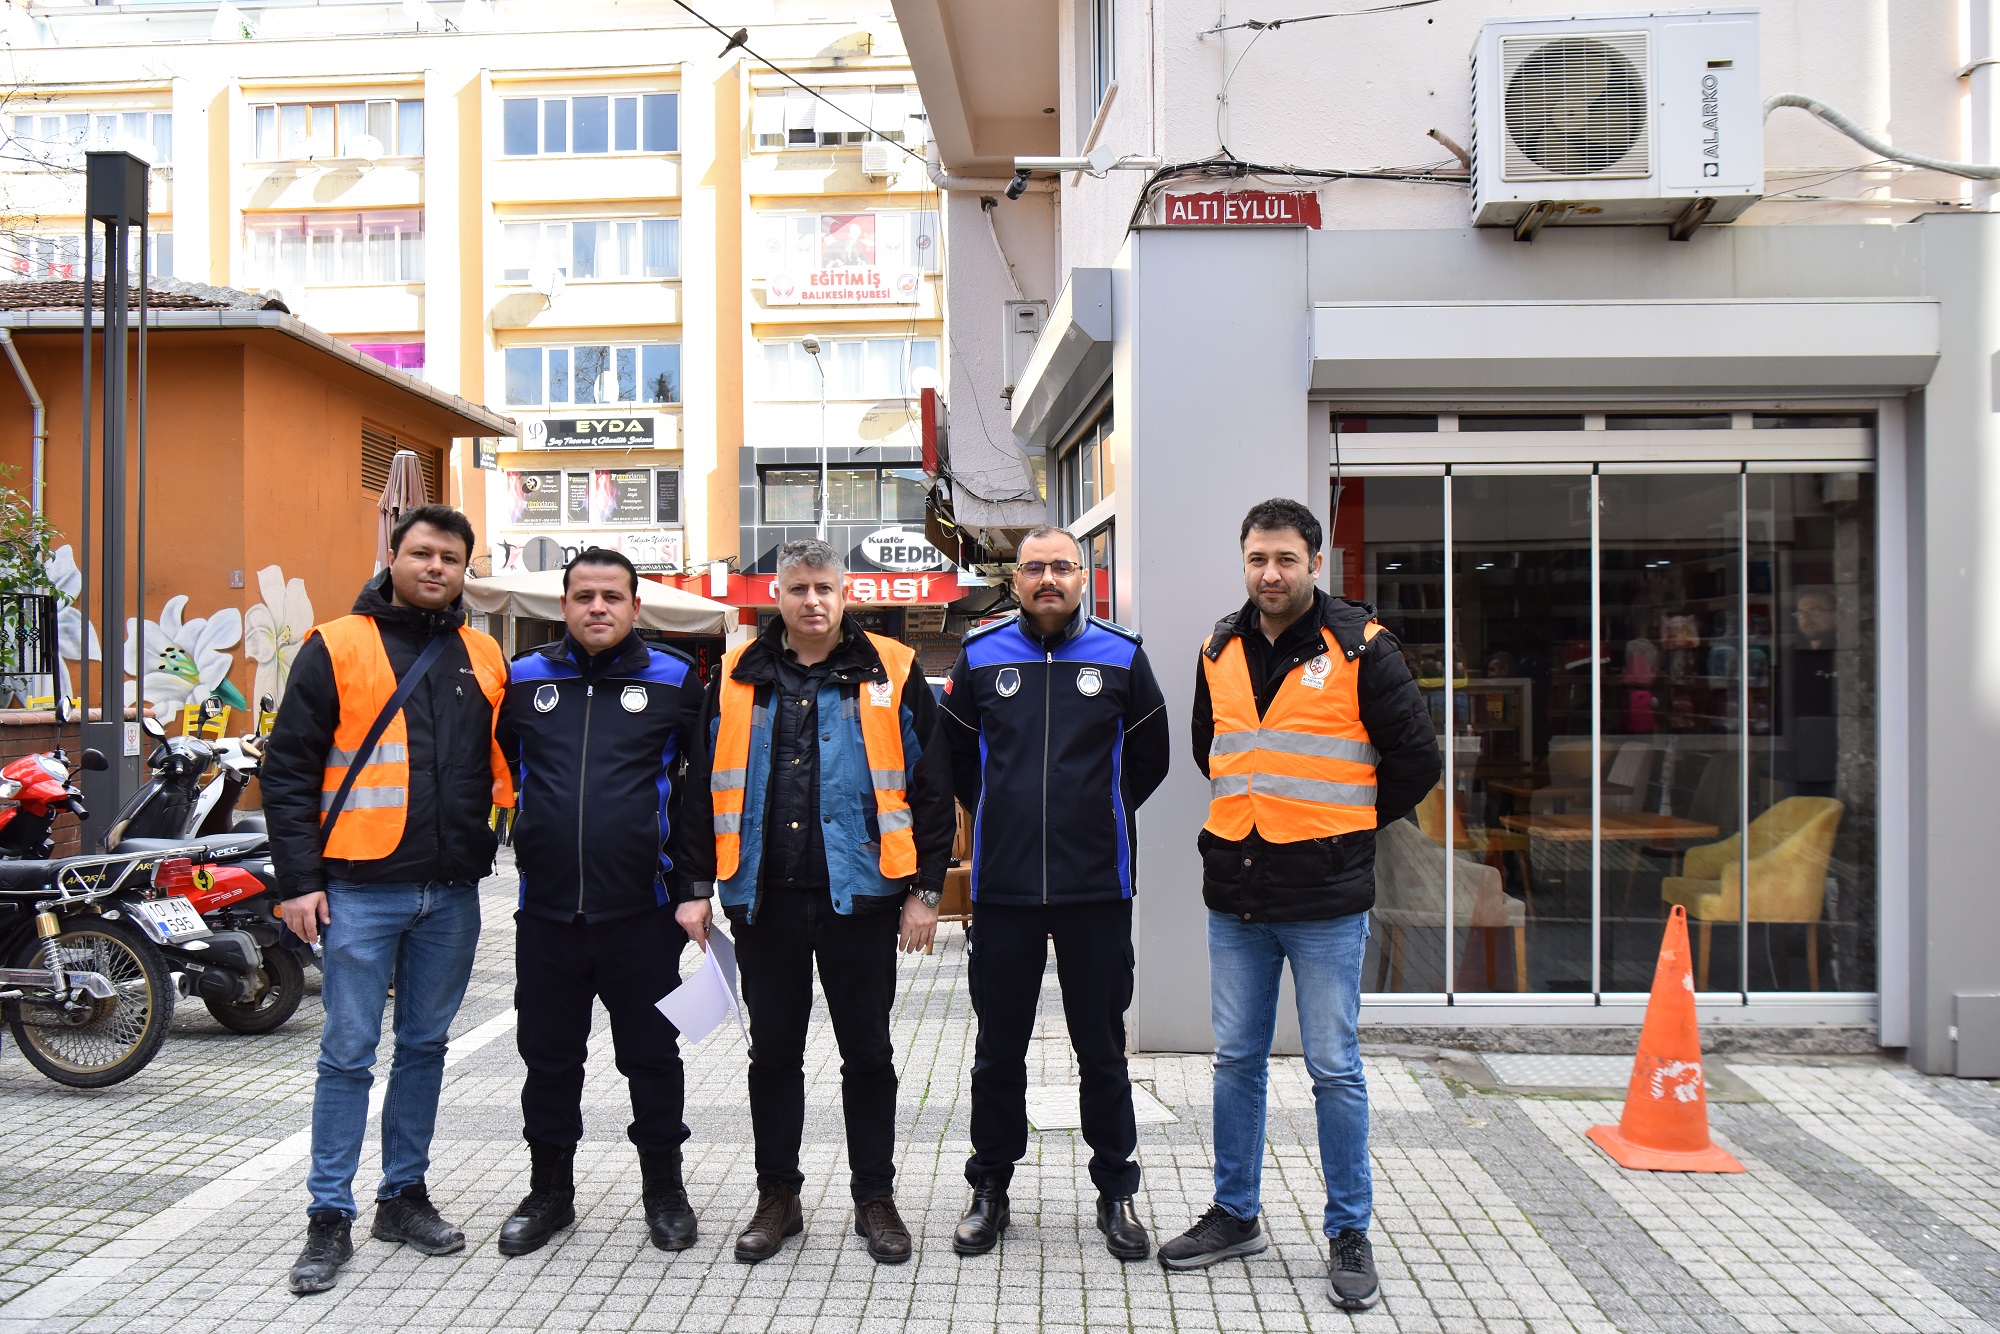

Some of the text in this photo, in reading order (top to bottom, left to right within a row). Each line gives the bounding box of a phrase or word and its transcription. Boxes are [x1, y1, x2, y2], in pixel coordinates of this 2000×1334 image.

[1702, 74, 1719, 158] ALARKO
[1225, 196, 1293, 219] EYLÜL
[810, 269, 881, 288] EĞİTİM İŞ
[801, 288, 891, 301] BALIKESİR ŞUBESİ
[575, 419, 645, 433] EYDA
[868, 536, 905, 544] Kuaför
[149, 900, 194, 918] 10 AIN
[167, 916, 195, 933] 595
